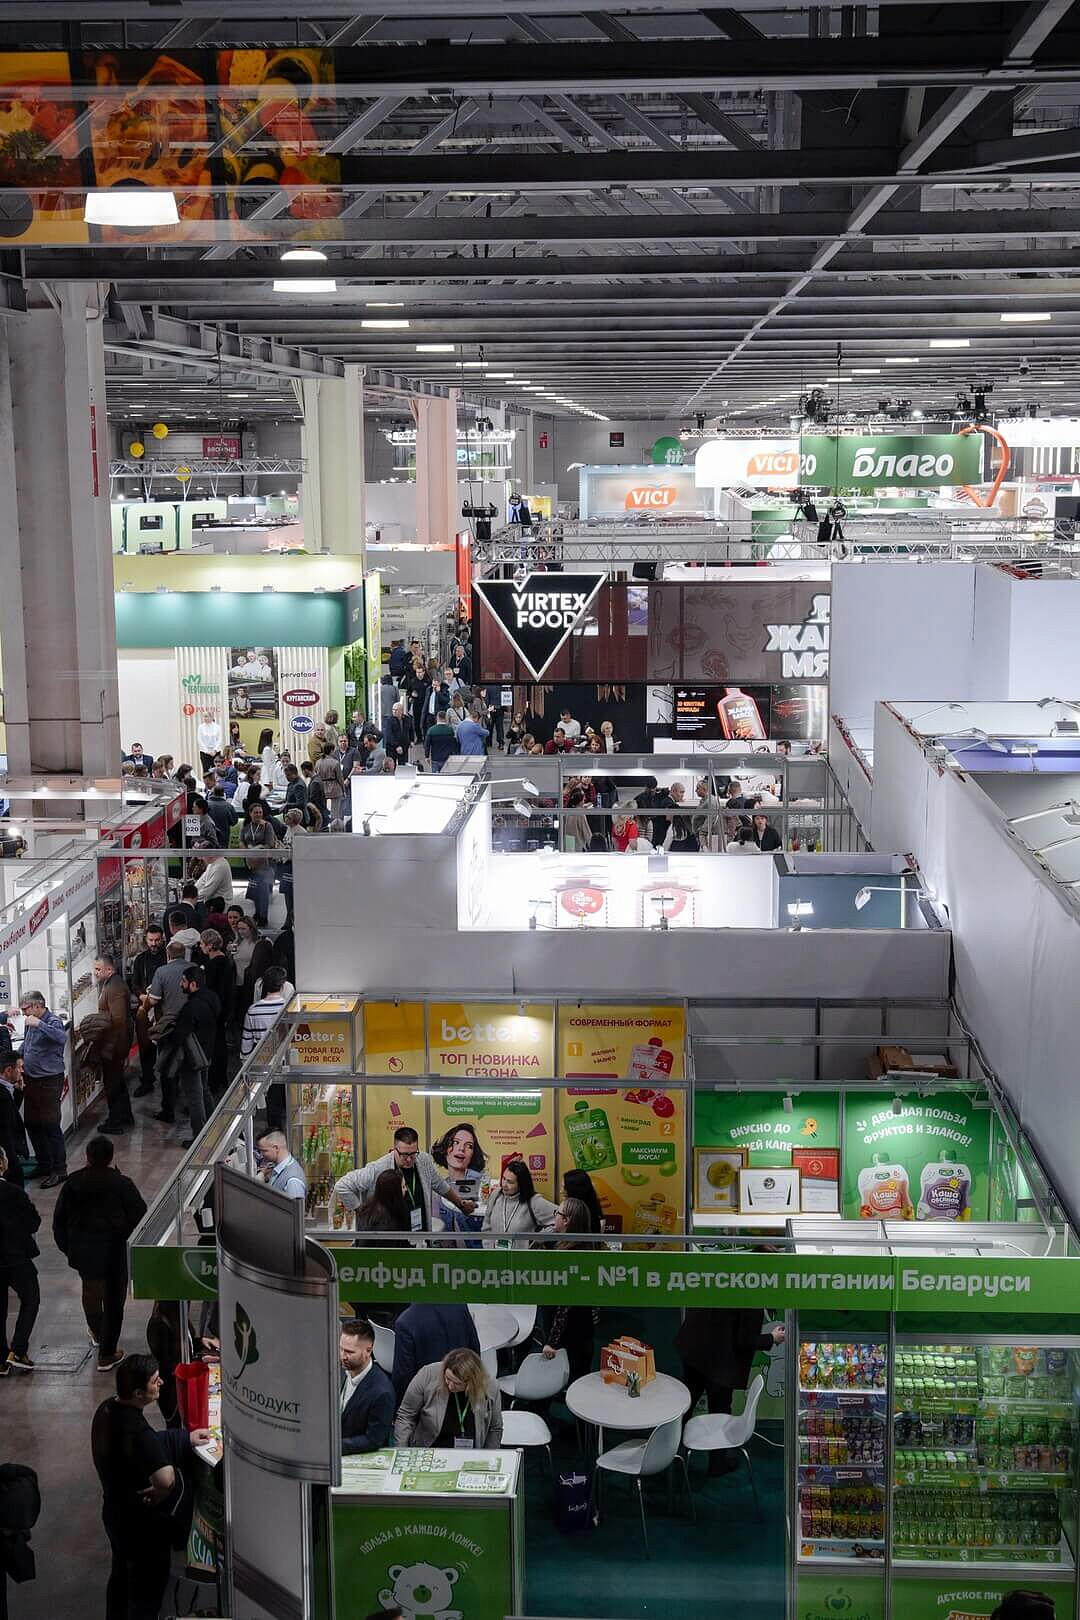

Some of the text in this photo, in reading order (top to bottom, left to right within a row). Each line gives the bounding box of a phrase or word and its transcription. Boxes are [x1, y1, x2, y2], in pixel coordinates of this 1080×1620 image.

[754, 456, 793, 472] VICI
[631, 490, 669, 505] VICI
[511, 593, 587, 611] VIRTEX
[516, 610, 577, 628] FOOD
[280, 671, 317, 679] pervafood
[569, 1018, 673, 1028] СОВРЕМЕННЫЙ ФОРМАТ
[440, 1054, 540, 1066] ТОП НОВИНКА
[465, 1068, 519, 1078] СЕЗОНА
[871, 1106, 968, 1126] ДВОНАЯ ПОЛЬЗА
[663, 1124, 672, 1135] 2
[730, 1123, 791, 1138] ВКУСНО ДО
[864, 1124, 972, 1148] ФРУКТОВ И ЗЛАКОВ!
[931, 1190, 959, 1200] Каша
[337, 1262, 426, 1289] елфуд
[598, 1266, 639, 1287] №1
[646, 1272, 661, 1287] в
[667, 1272, 778, 1292] детском
[785, 1272, 895, 1290] питании
[902, 1269, 1030, 1297] Беларуси
[242, 1386, 301, 1414] продукт
[360, 1522, 484, 1557] ПОЛЬЗА В КАЖДОЙ ЛОЖКЕ!
[937, 1592, 982, 1607] ДЕТСКОЕ
